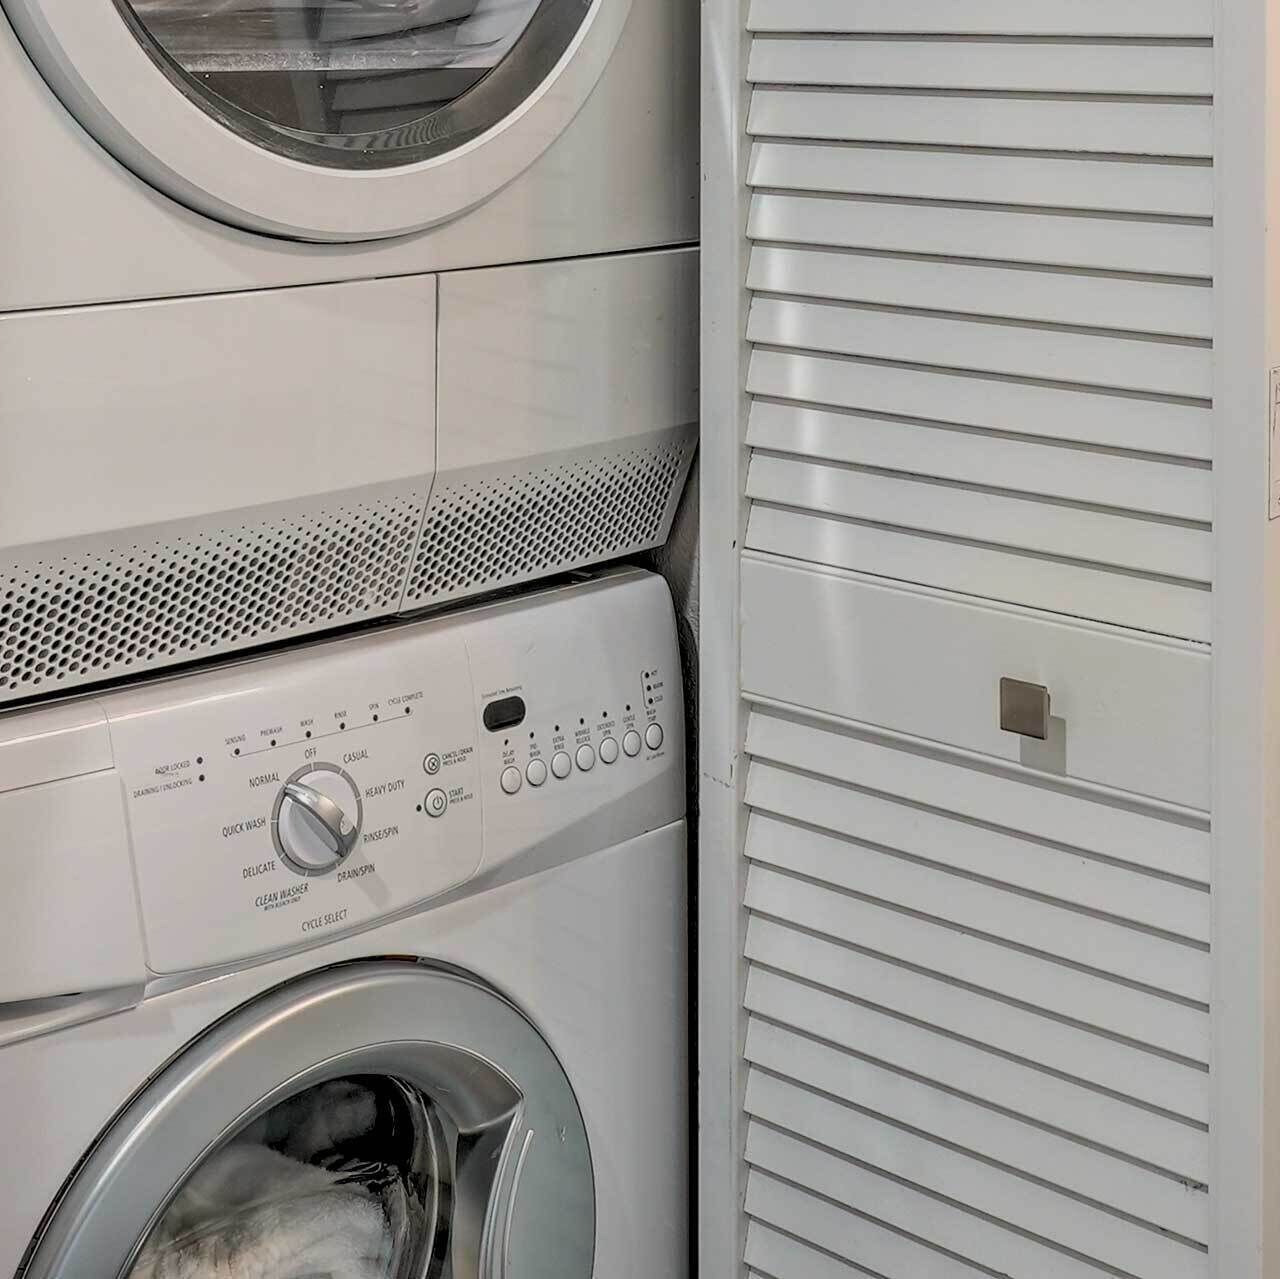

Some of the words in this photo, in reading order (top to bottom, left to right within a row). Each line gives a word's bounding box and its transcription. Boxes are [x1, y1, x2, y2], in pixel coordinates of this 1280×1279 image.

[304, 747, 317, 760] OFF
[343, 749, 369, 764] CASUAL
[249, 772, 280, 788] NORMAL
[365, 784, 387, 798] HEAVY
[388, 779, 405, 793] DUTY
[222, 822, 246, 838] QUICK
[246, 817, 266, 832] WASH
[363, 826, 399, 843] RINSE/SPIN
[242, 860, 276, 879] DELICATE
[337, 864, 376, 883] DRAIN/SPIN
[255, 890, 279, 908] CLEAN
[279, 883, 309, 901] WASHER
[301, 917, 322, 932] CYCLE
[323, 909, 348, 926] SELECT
